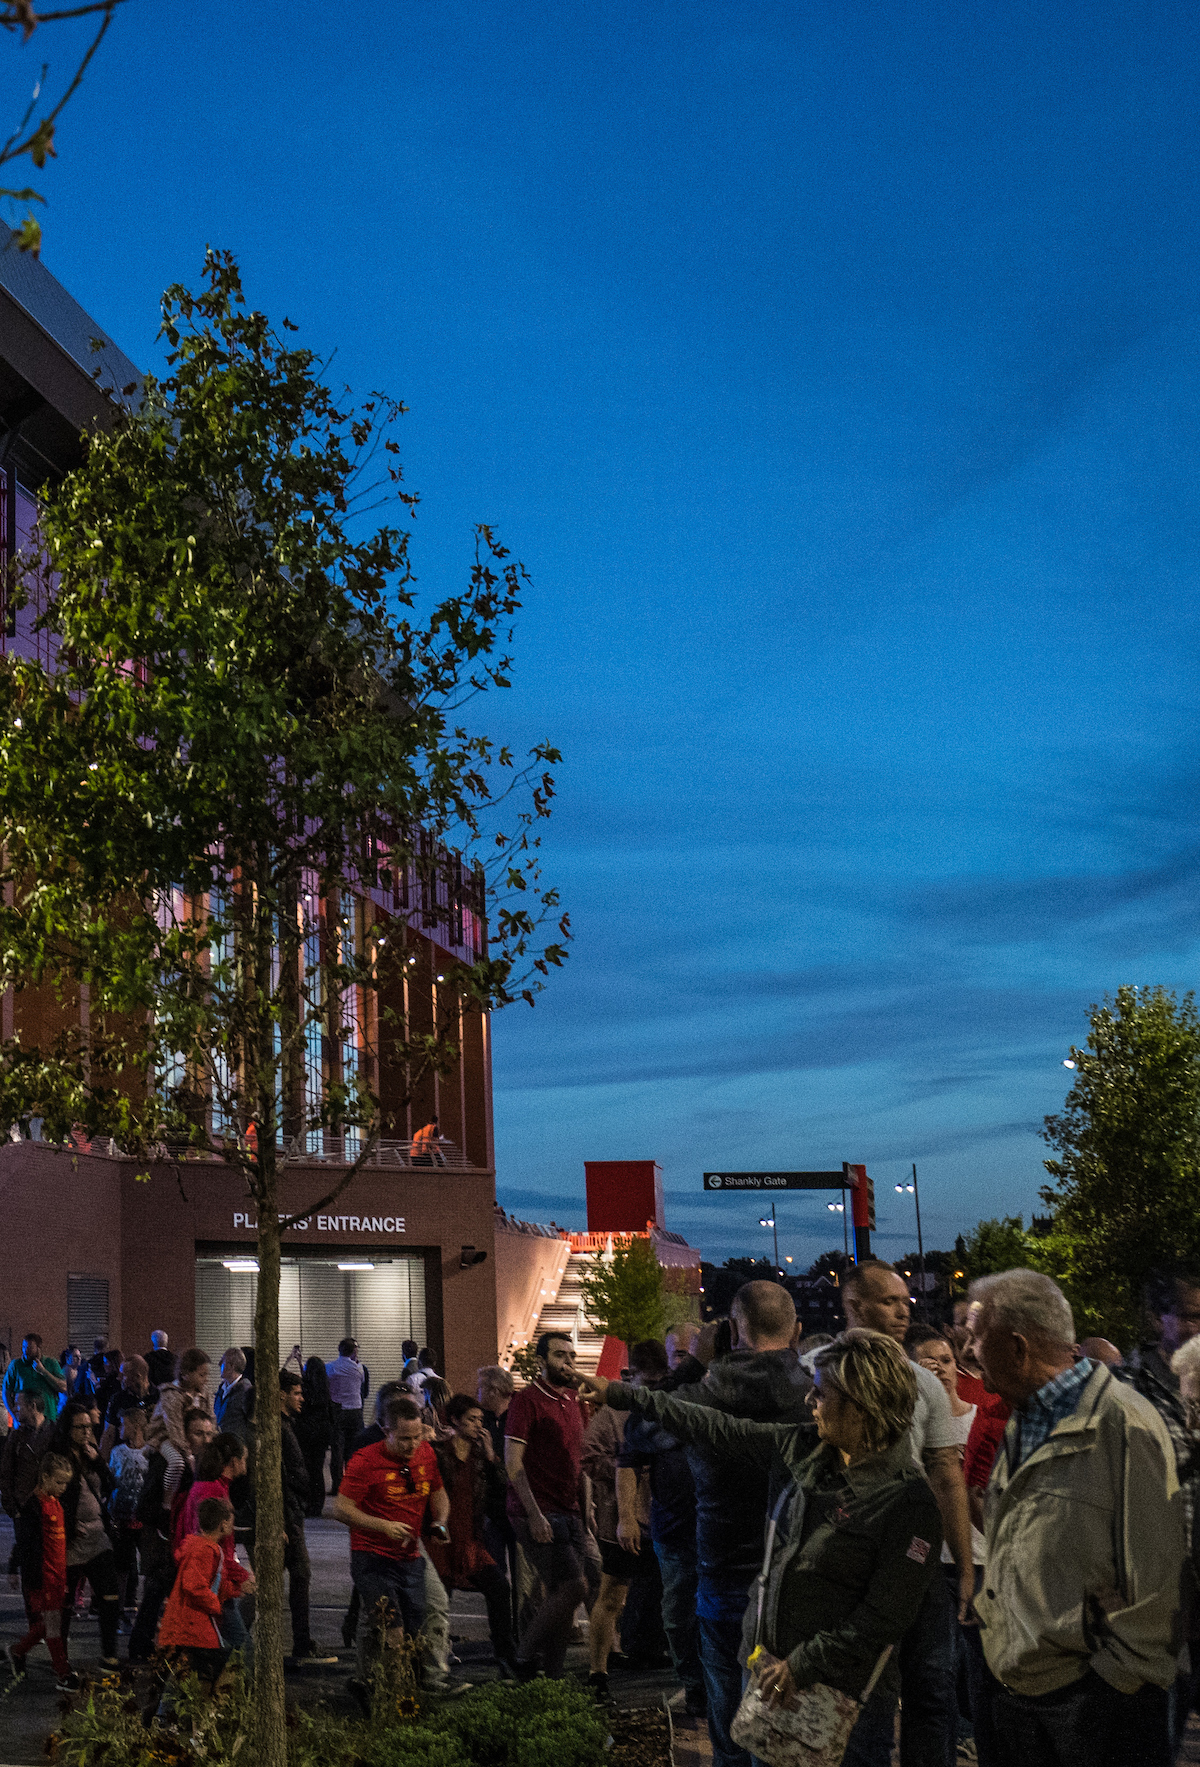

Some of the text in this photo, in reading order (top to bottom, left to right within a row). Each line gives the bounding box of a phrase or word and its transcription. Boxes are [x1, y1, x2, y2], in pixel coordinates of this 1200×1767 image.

[724, 1176, 787, 1187] Shankly Gate
[233, 1212, 406, 1233] PLES' ENTRANCE
